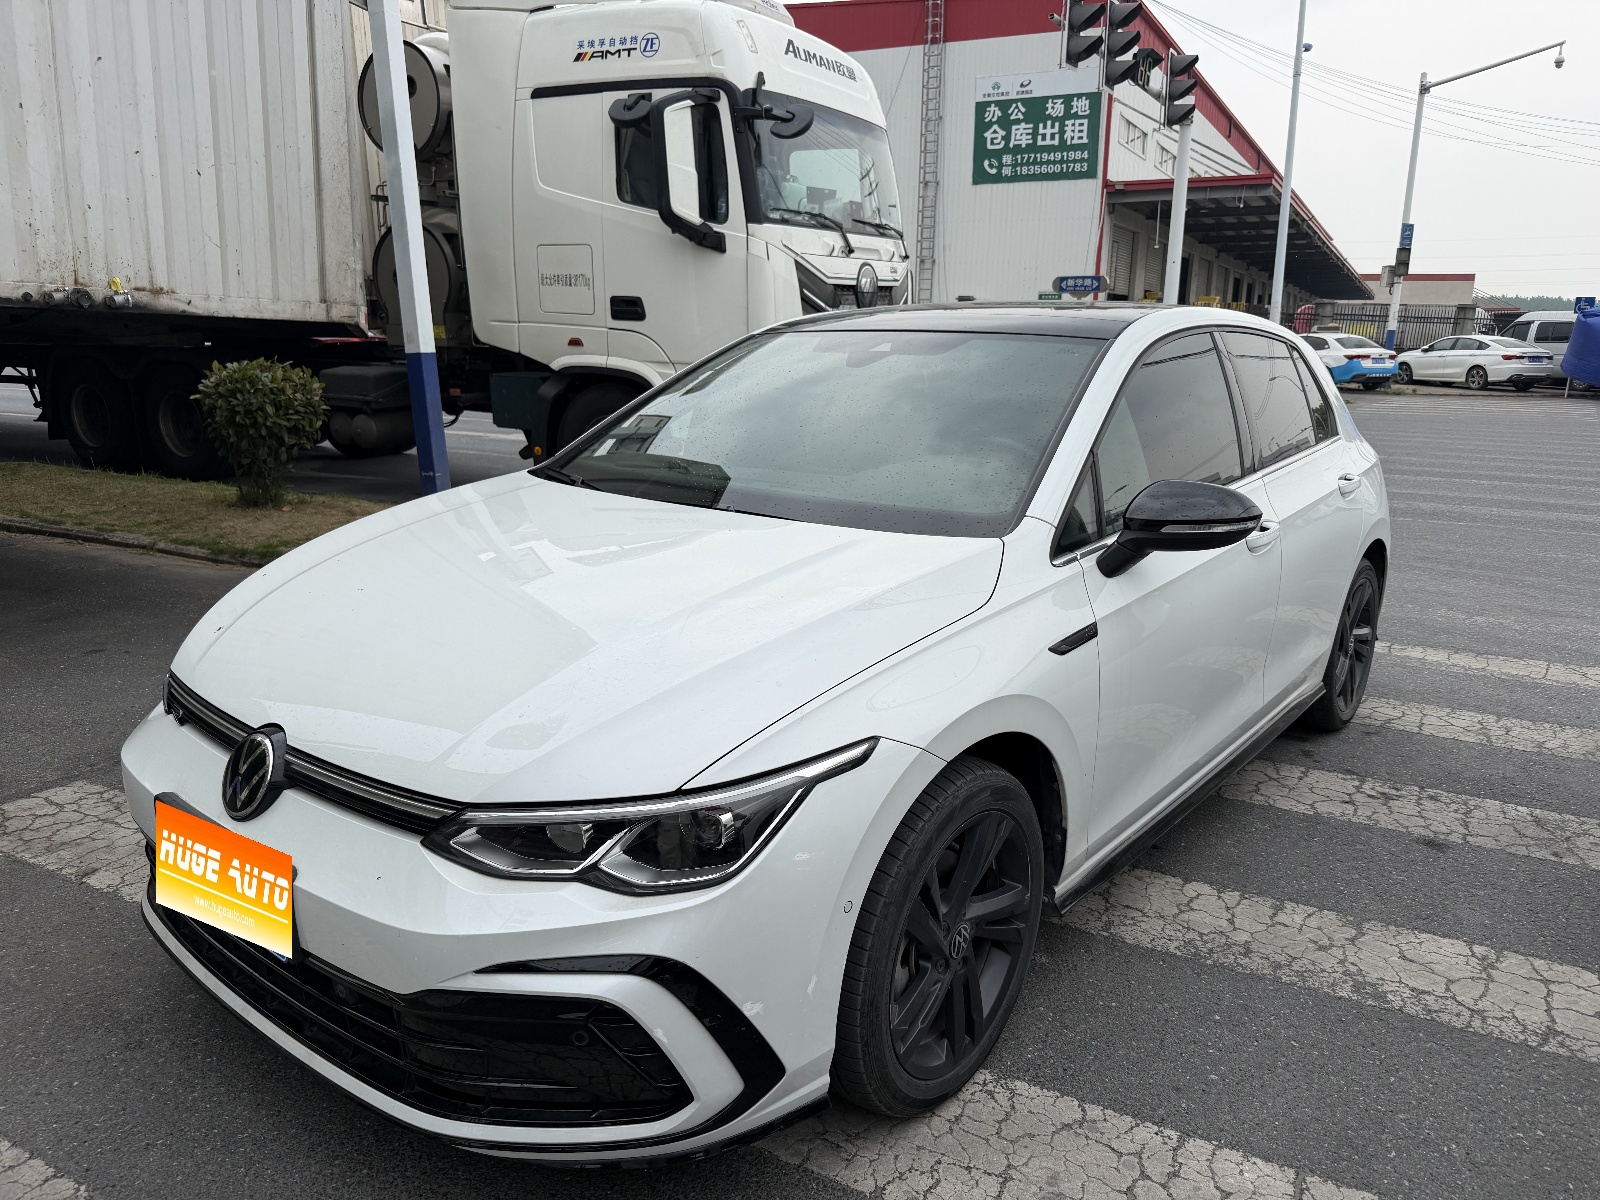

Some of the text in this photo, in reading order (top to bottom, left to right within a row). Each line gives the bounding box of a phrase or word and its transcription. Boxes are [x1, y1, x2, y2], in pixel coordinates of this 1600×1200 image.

[577, 35, 639, 50] 采埃孚自动挡
[587, 47, 638, 61] AMT
[984, 96, 1091, 123] 办公 场地
[983, 118, 1089, 150] 仓库出租
